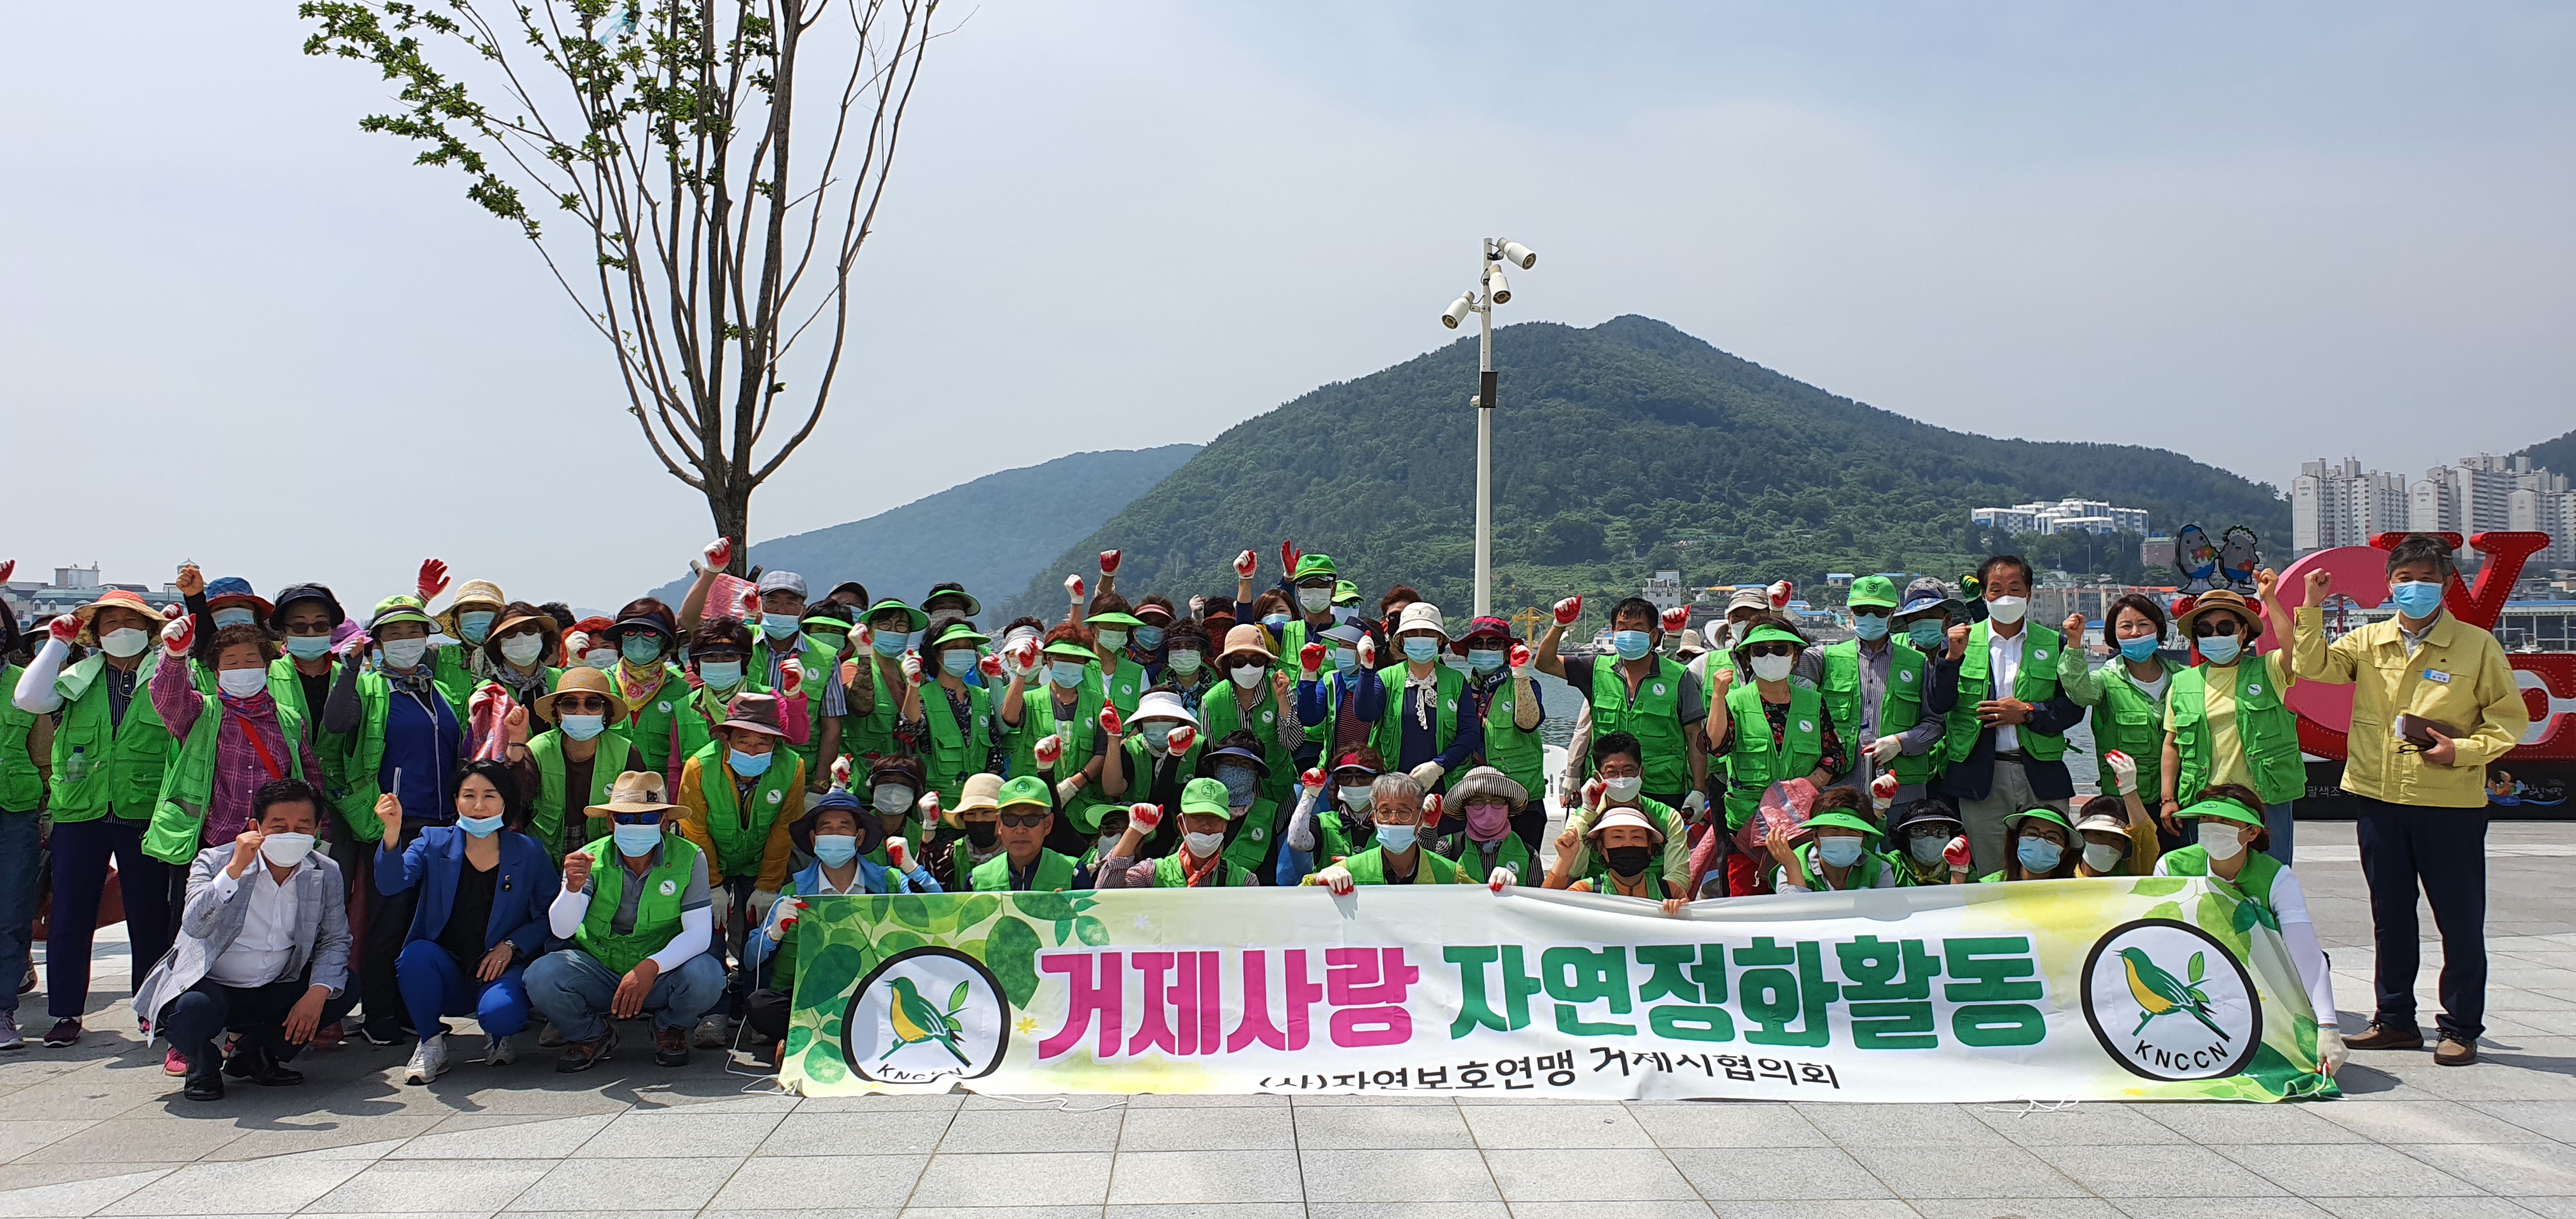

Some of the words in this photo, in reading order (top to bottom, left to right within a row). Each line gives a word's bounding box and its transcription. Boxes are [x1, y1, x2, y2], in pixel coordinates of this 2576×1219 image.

[2306, 785, 2341, 798] 팔색조
[1038, 947, 1420, 1060] 거제사랑
[1443, 935, 2047, 1050] 자연정화활동
[1259, 1049, 1576, 1090] (사)자연보호연맹
[1590, 1046, 1841, 1089] 거제시협의회
[2134, 1039, 2229, 1071] KNCCN
